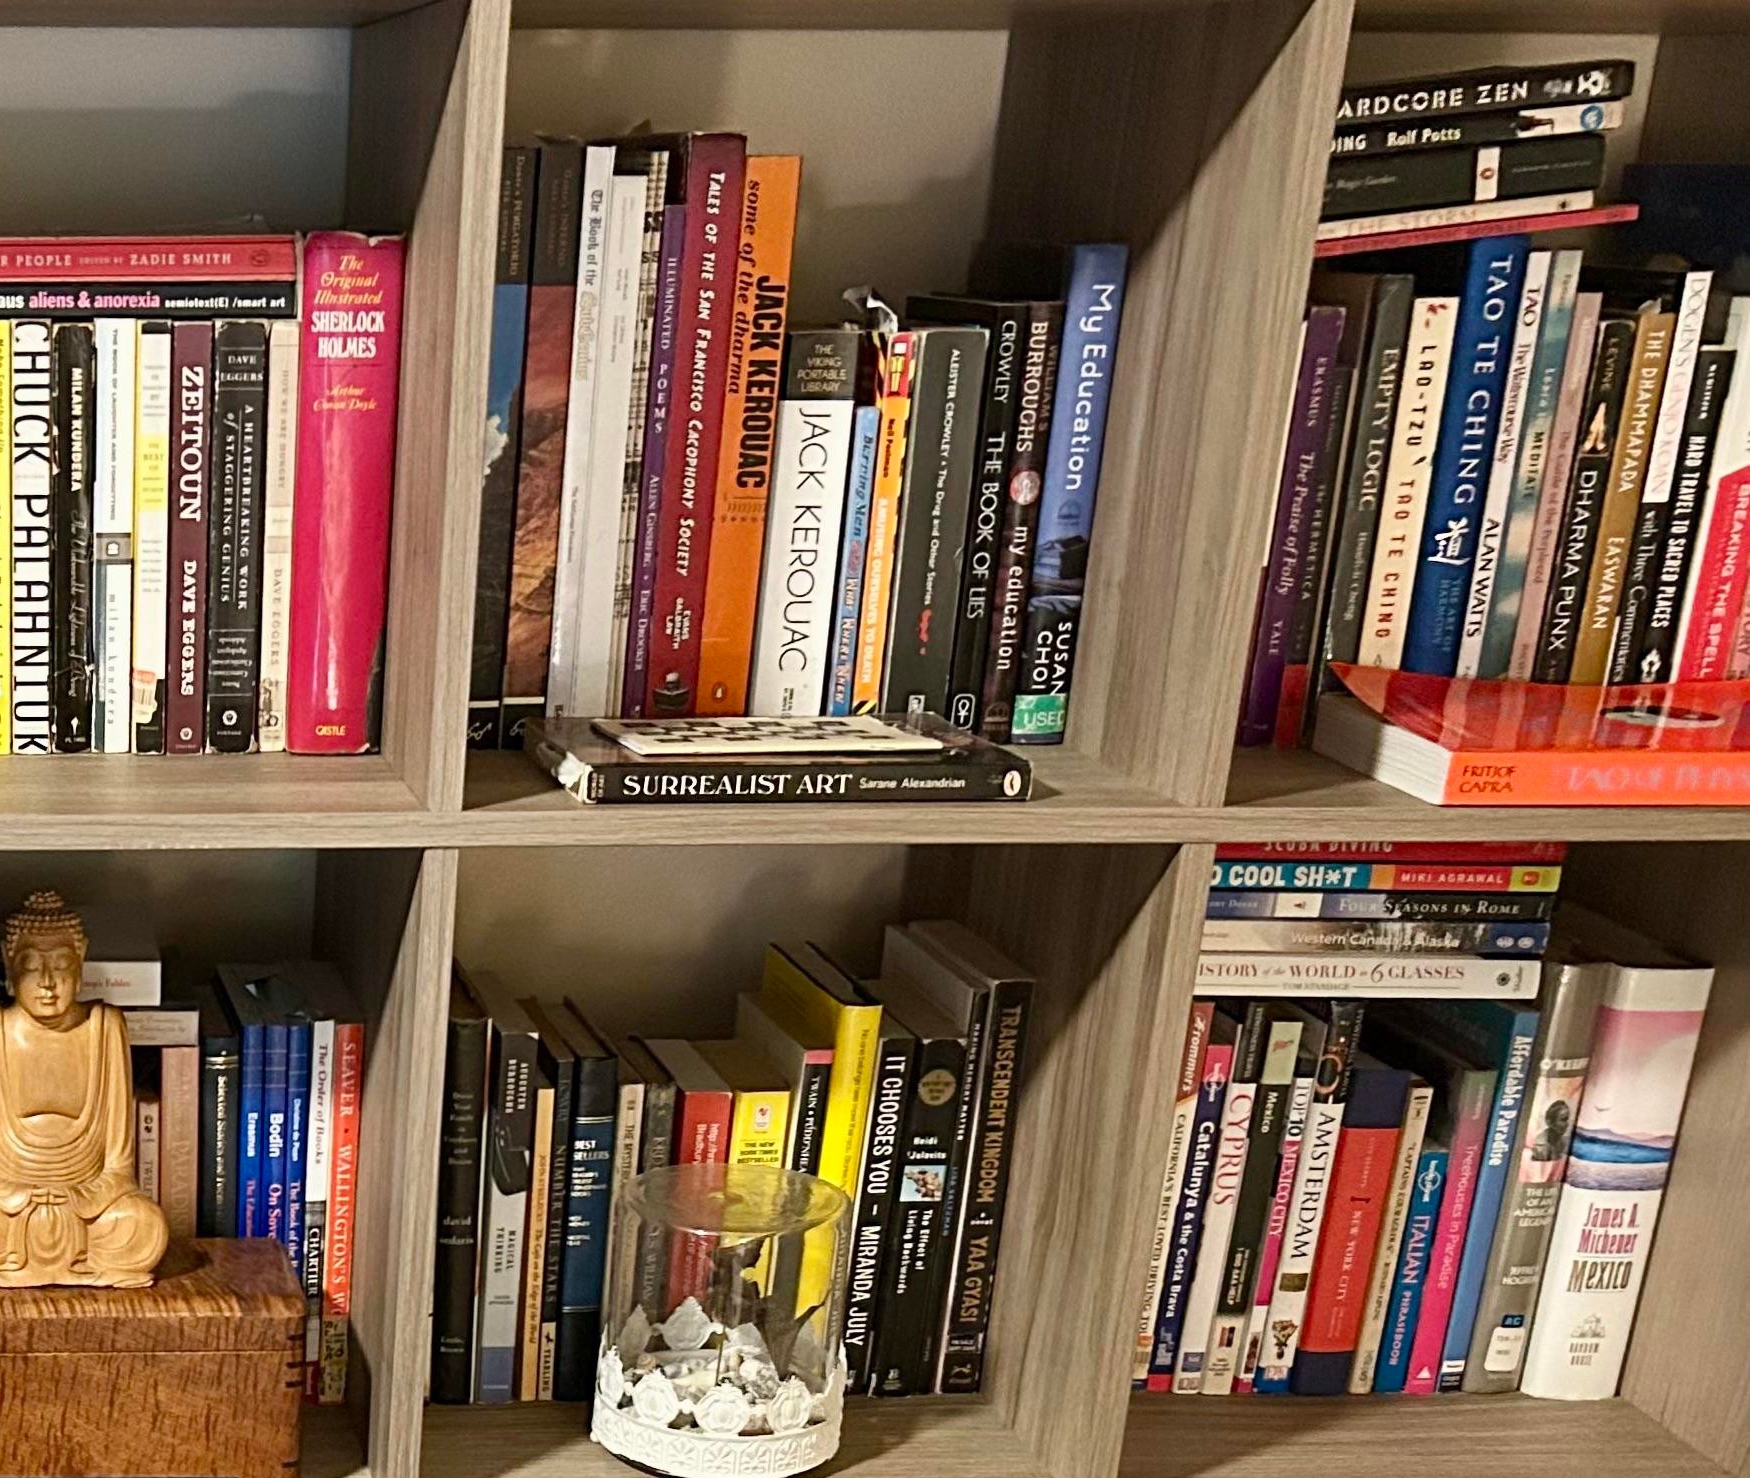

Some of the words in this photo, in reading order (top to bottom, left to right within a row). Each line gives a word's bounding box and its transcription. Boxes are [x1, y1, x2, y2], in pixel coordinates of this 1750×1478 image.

[1477, 81, 1528, 102] ZEN
[16, 254, 72, 268] PEOPLE
[130, 254, 174, 265] ZADIE
[179, 253, 231, 264] SMITH
[320, 273, 379, 290] Original
[702, 249, 715, 281] THE
[1483, 254, 1514, 322] TAO
[29, 293, 74, 308] aliens
[78, 293, 90, 307] &
[95, 293, 160, 308] anorexia
[312, 311, 384, 334] SHERLOCK
[314, 290, 383, 305] Illustrated
[755, 275, 786, 351] JACK
[1080, 285, 1116, 333] My
[319, 336, 377, 358] HOLMES
[1474, 336, 1499, 375] TE
[14, 322, 48, 464] CHUCK
[1066, 343, 1107, 491] Education
[181, 366, 203, 521] ZEITOUN
[736, 356, 781, 491] KEROUAC
[798, 408, 831, 490] JACK
[1453, 388, 1491, 505] CHING
[1474, 518, 1501, 572] ALAN
[1561, 470, 1599, 580] DHARMA
[184, 560, 197, 615] DAVE
[777, 504, 822, 672] KEROUAC
[1466, 571, 1492, 638] WATTS
[1547, 581, 1577, 649] PUNX
[14, 493, 49, 752] PALAHNIUK
[181, 621, 196, 697] EGGERS
[1032, 630, 1053, 691] CHOI
[1052, 621, 1072, 695] SUSAN
[623, 773, 790, 796] SURREALIST
[797, 773, 852, 794] ART
[1229, 867, 1286, 885] COOL
[886, 1056, 906, 1075] IT
[874, 1078, 903, 1155] CHOOSES
[868, 1159, 891, 1194] YOU
[1213, 1093, 1252, 1205] CYPRUS
[1290, 1112, 1337, 1260] AMSTERDAM
[1577, 1228, 1639, 1254] Michener
[1583, 1202, 1626, 1229] James
[853, 1225, 880, 1303] MIRANDA
[844, 1307, 868, 1345] JULY
